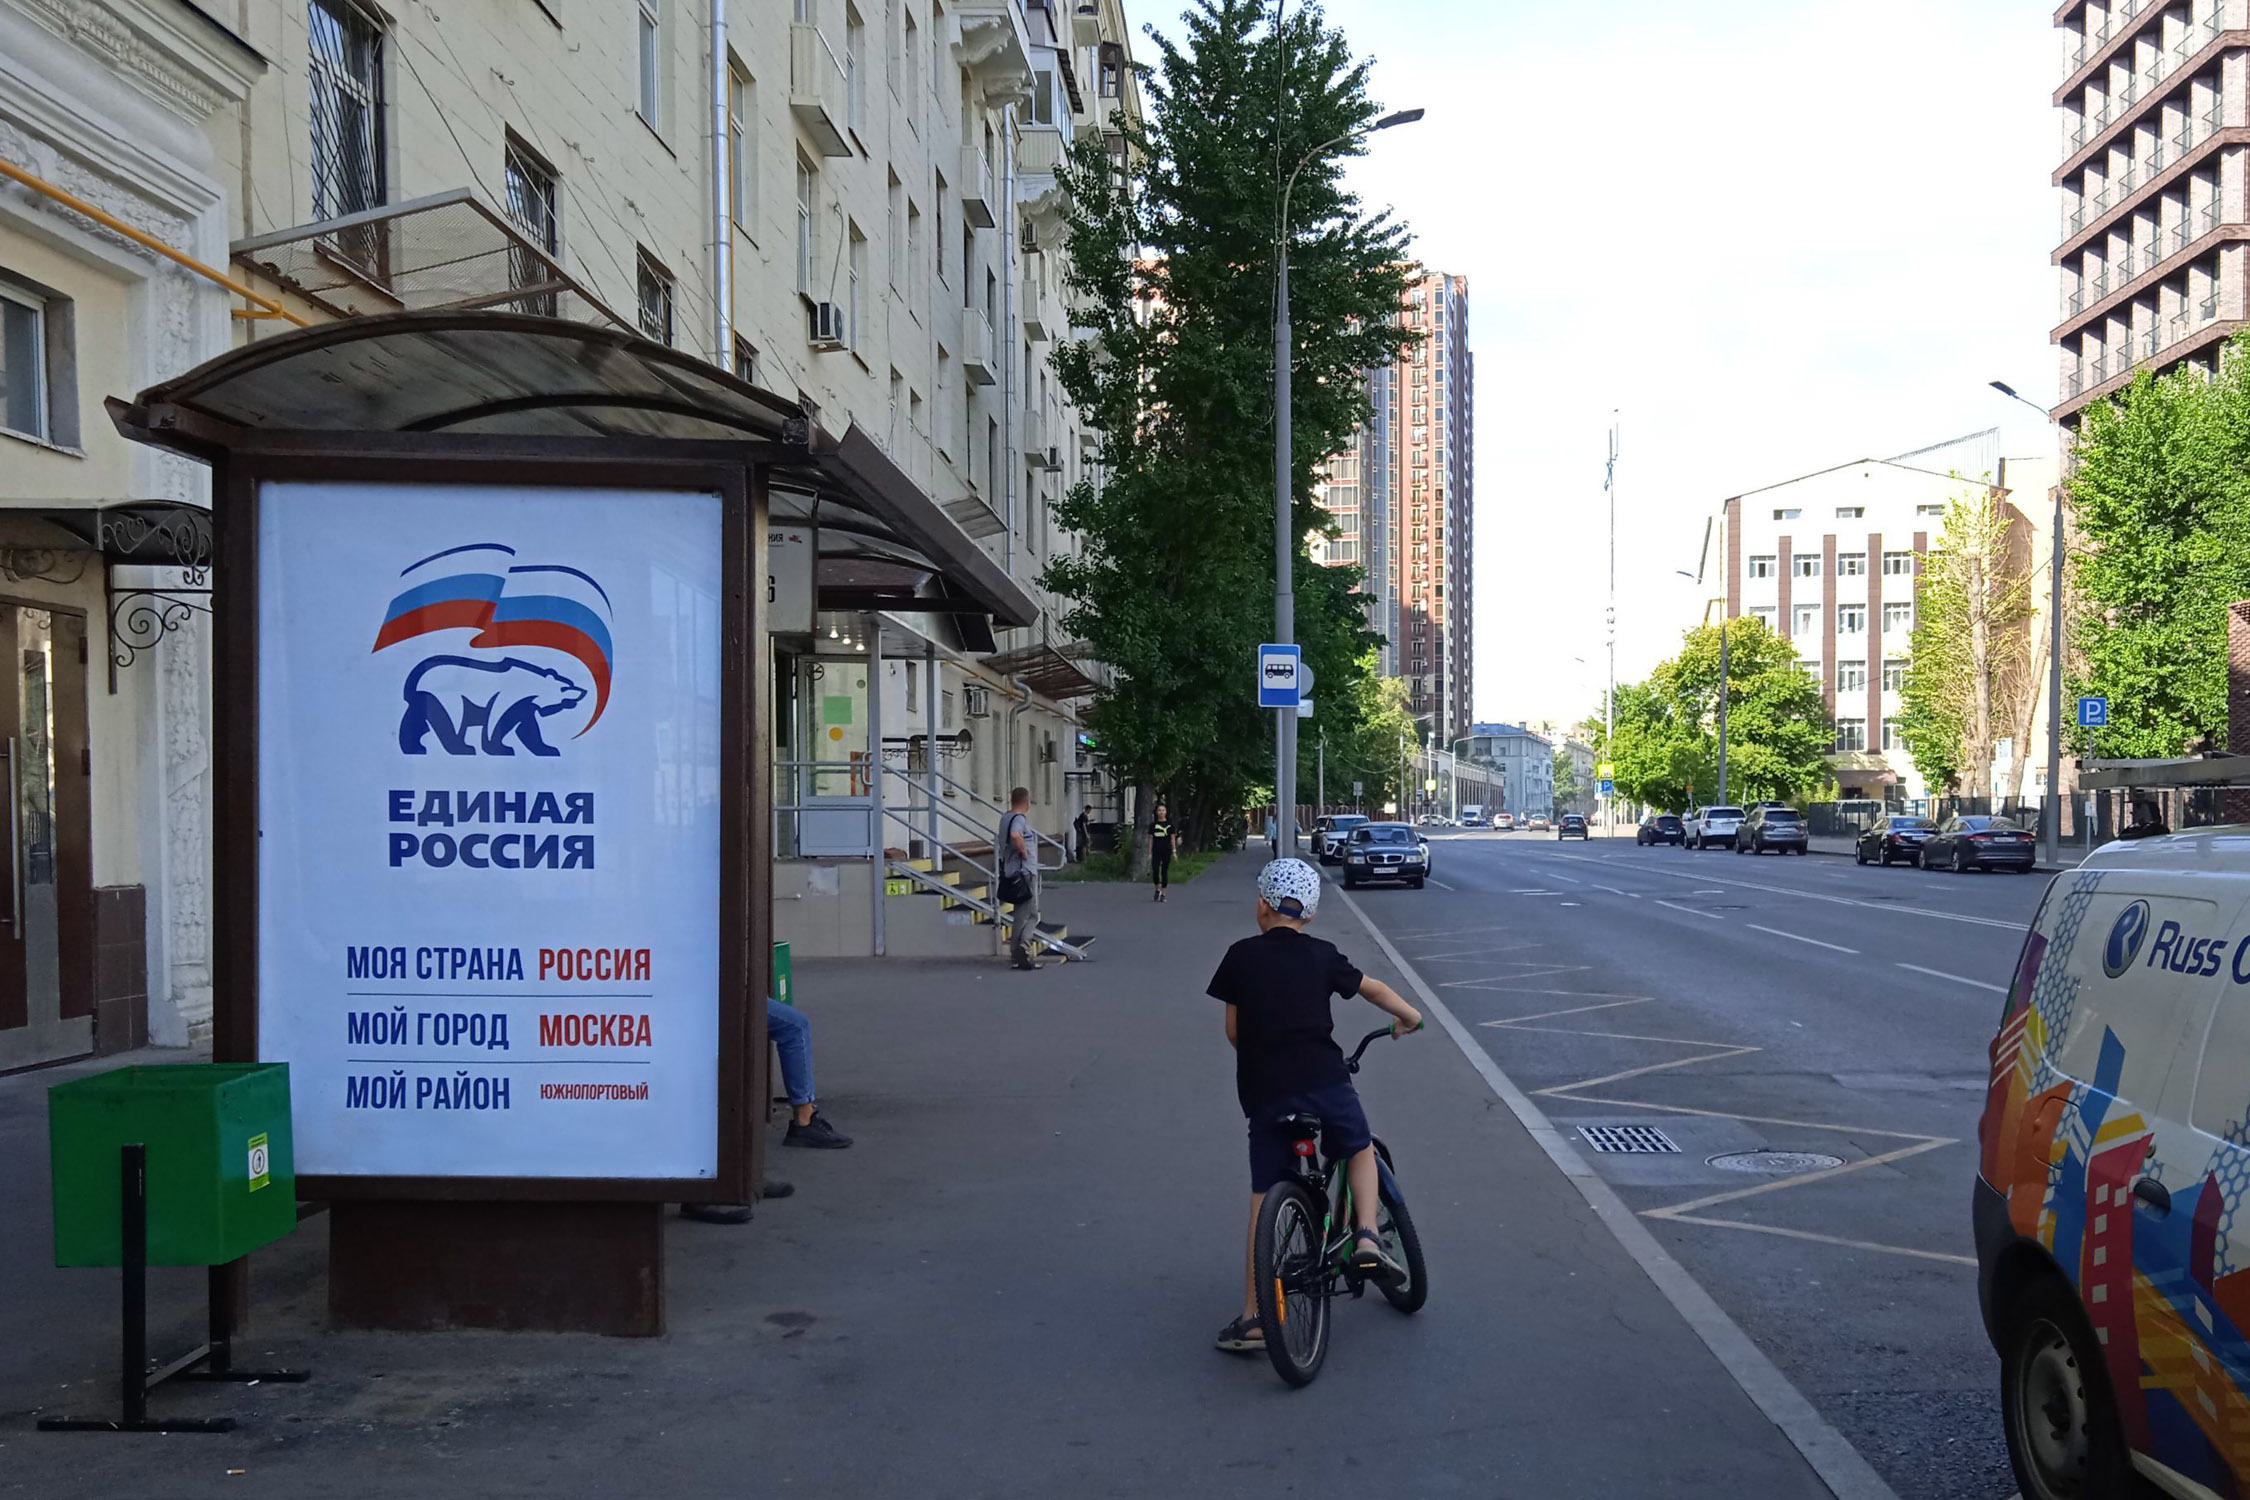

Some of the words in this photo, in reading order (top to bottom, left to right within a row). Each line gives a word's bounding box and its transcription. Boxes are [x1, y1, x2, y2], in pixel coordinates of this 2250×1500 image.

[2086, 701, 2102, 723] P
[388, 789, 595, 828] ЕДИНАЯ
[388, 832, 595, 870] РОССИЯ
[347, 946, 407, 979] МОЯ
[416, 946, 524, 981] СТРАНА
[539, 948, 651, 981] РОССИЯ
[2147, 920, 2229, 977] Russ
[347, 1005, 408, 1045] МОЙ
[417, 1012, 510, 1050] ГОРОД
[539, 1014, 652, 1047] МОСКВА
[346, 1069, 407, 1110] МОЙ
[416, 1070, 511, 1110] РАЙОН
[540, 1081, 649, 1101] ЮЖНОПОРТОВЫЙ
